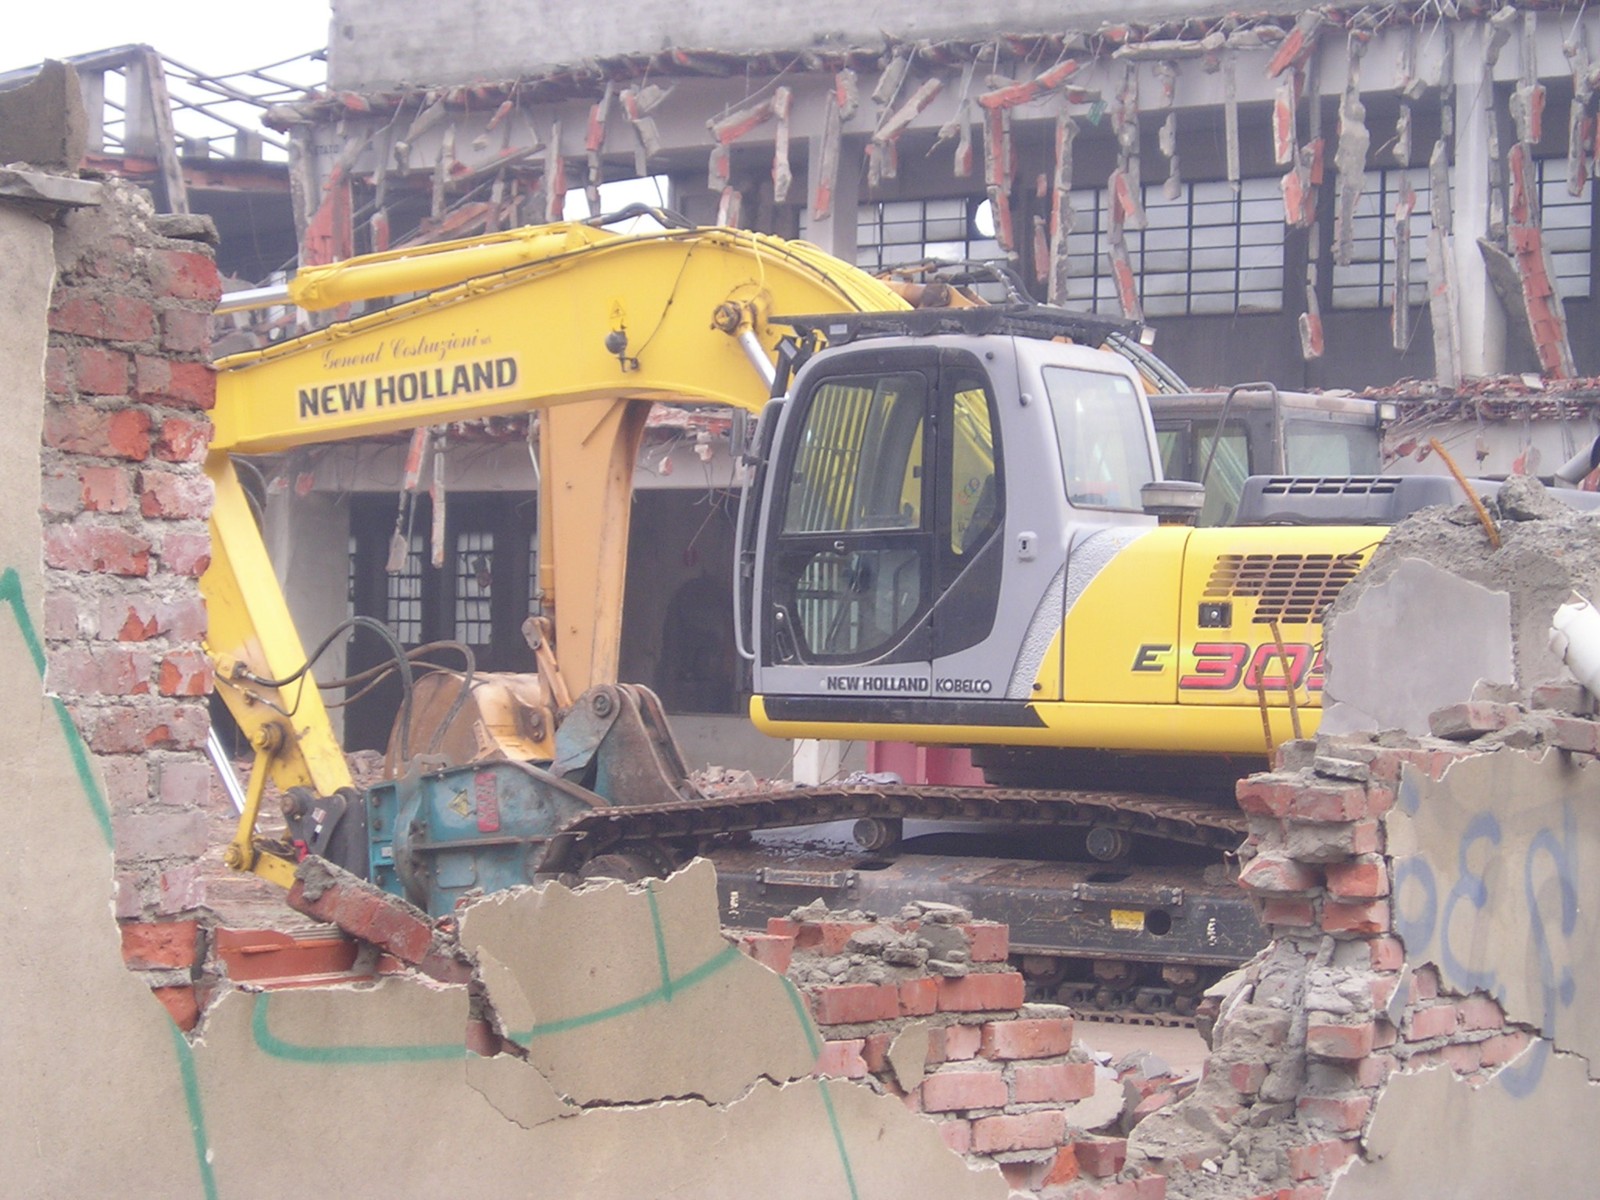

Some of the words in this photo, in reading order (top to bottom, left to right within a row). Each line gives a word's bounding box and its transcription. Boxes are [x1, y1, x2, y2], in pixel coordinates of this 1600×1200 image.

[322, 341, 384, 369] General
[390, 329, 479, 361] Costruzioni
[299, 380, 366, 417] NEW
[375, 357, 518, 407] HOLLAND
[1131, 644, 1171, 671] E
[827, 676, 860, 691] NEW
[863, 677, 929, 692] HOLLAND
[935, 679, 992, 693] KOBELCO
